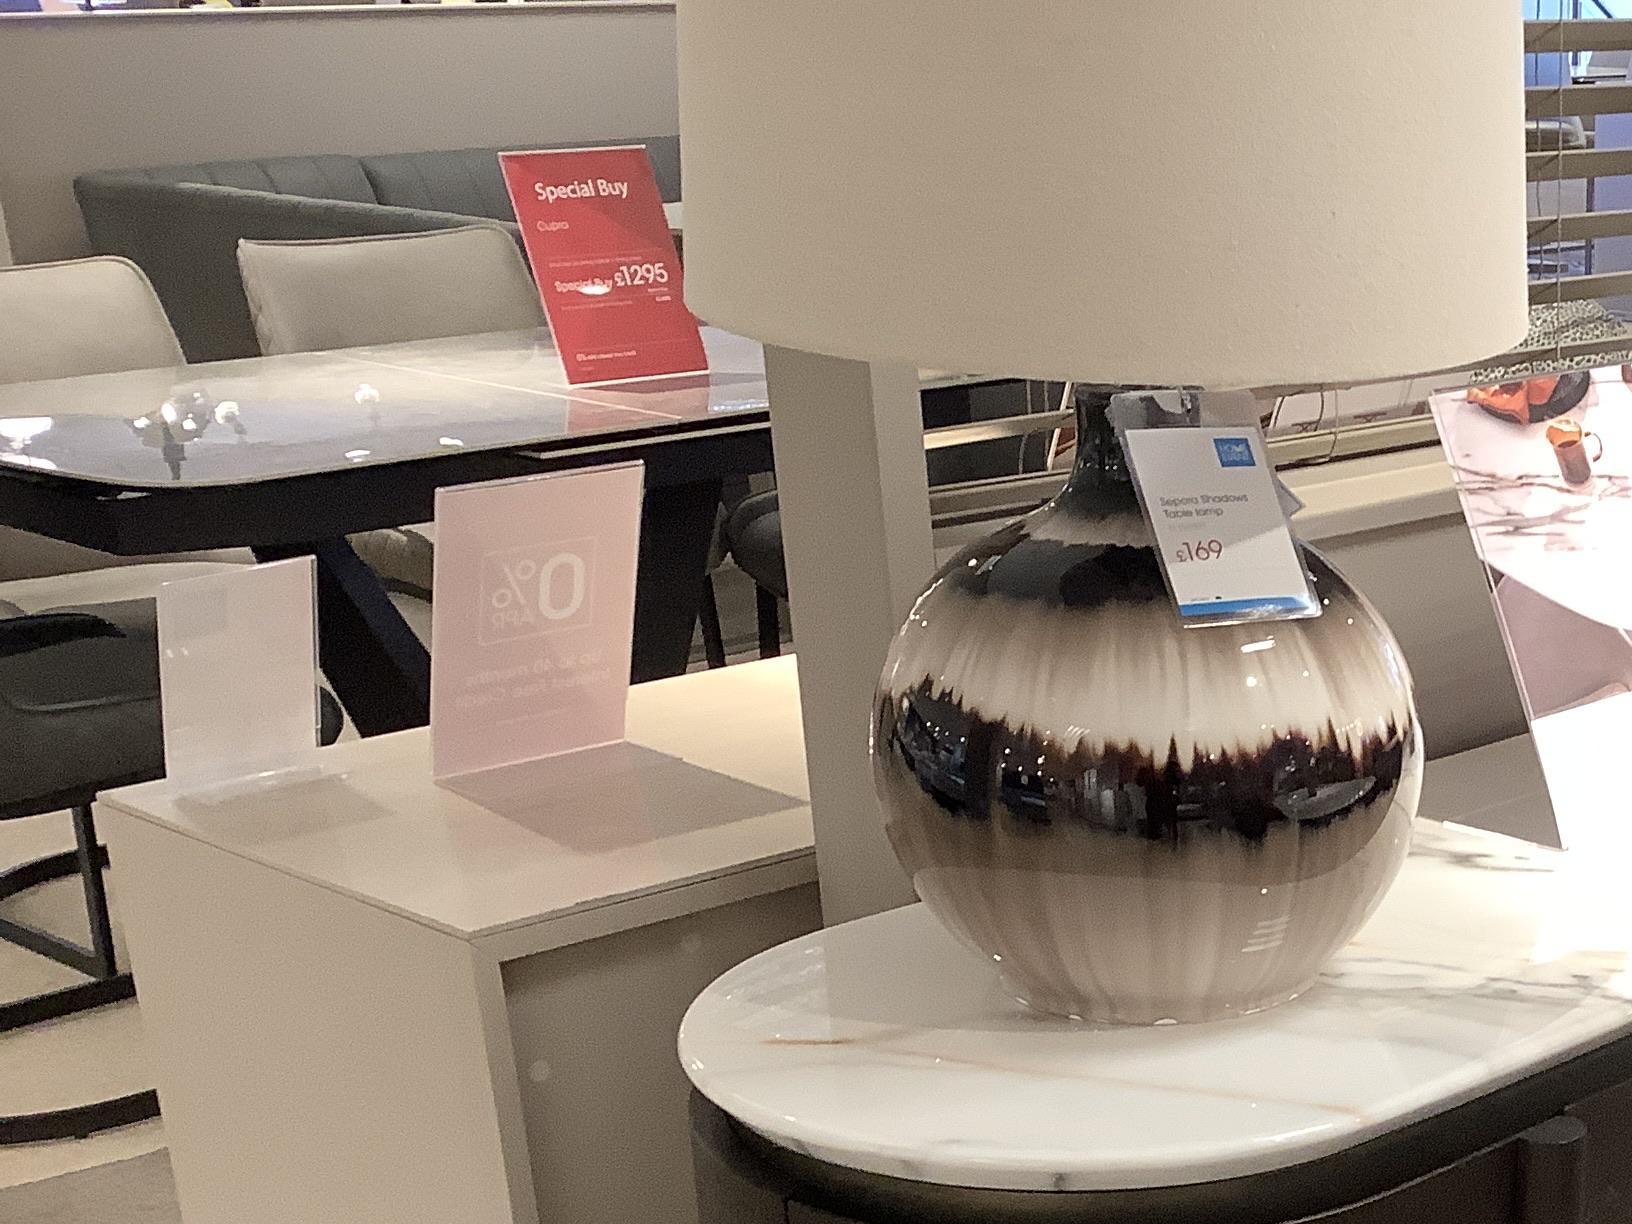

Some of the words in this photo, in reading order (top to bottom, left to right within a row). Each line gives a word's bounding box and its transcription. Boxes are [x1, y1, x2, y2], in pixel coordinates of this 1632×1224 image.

[534, 179, 595, 203] Special
[597, 178, 629, 199] Buy
[614, 262, 669, 287] £1295
[1163, 509, 1193, 518] Table
[1176, 539, 1223, 562] £169
